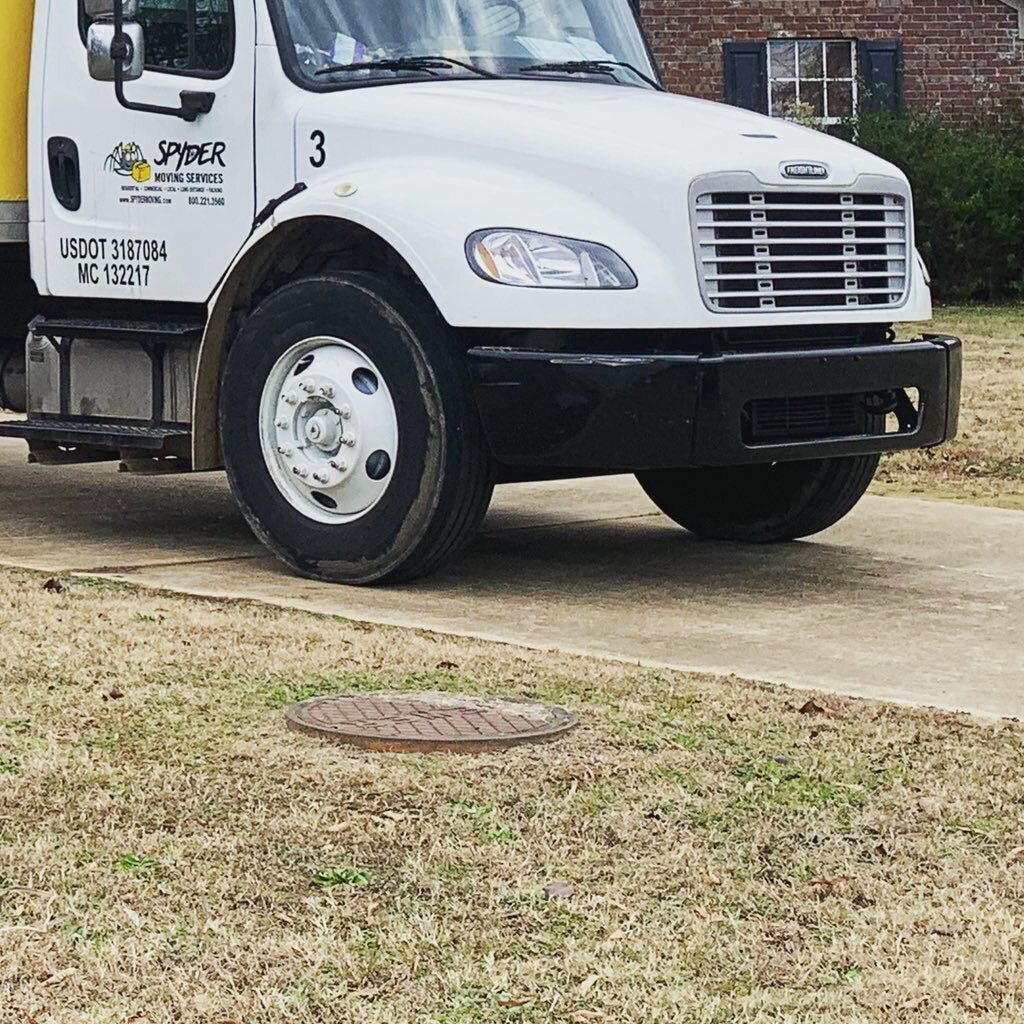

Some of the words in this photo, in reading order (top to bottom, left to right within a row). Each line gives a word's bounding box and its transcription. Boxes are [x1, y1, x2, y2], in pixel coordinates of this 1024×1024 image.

[153, 140, 226, 172] SPYDER
[309, 129, 326, 168] 3
[154, 172, 184, 183] MOVING
[186, 172, 224, 184] SERVICES
[60, 237, 106, 260] USDOT
[111, 238, 168, 262] 3187084
[78, 263, 99, 284] MC
[103, 263, 150, 286] 132217
